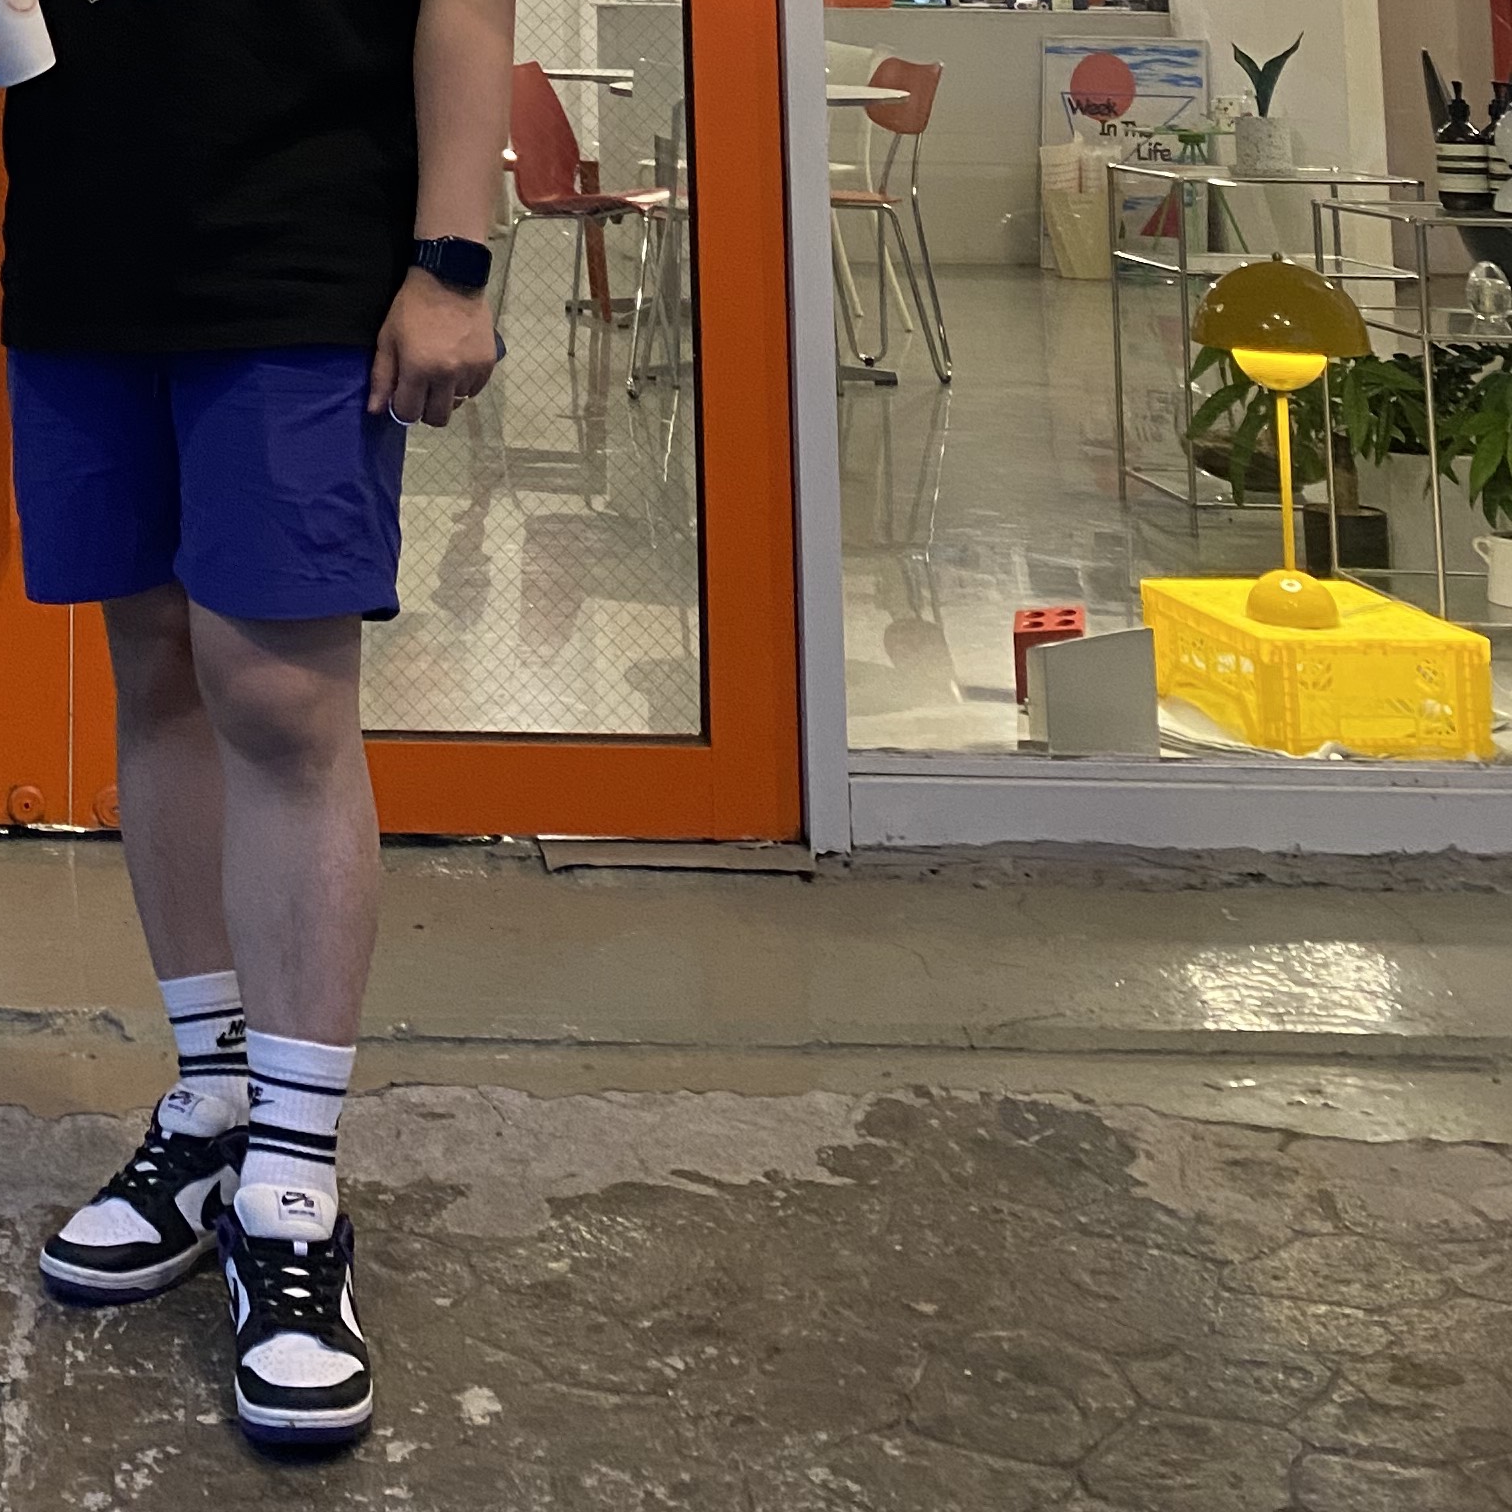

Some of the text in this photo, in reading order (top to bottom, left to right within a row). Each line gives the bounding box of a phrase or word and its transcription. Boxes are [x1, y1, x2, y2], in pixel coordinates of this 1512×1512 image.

[1067, 97, 1119, 117] Week
[1100, 120, 1117, 137] In
[1136, 142, 1172, 163] Life
[228, 1019, 247, 1036] NI
